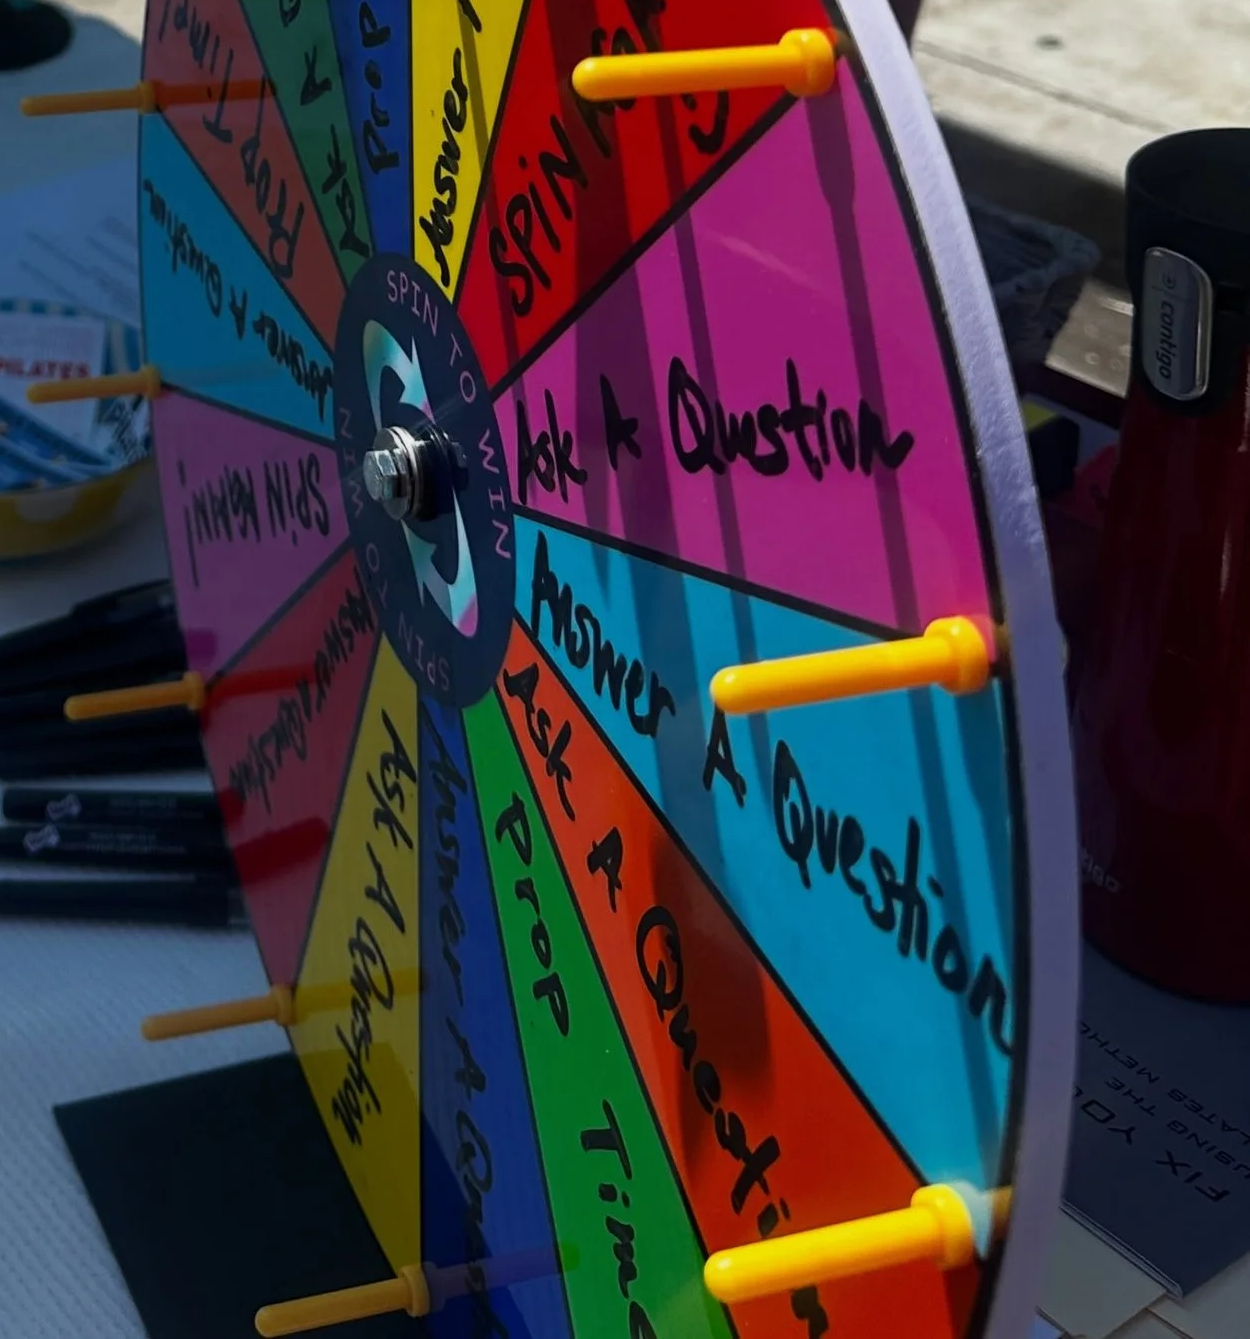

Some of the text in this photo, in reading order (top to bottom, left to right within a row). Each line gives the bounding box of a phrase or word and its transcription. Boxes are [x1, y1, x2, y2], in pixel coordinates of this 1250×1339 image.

[300, 45, 332, 106] A
[358, 2, 399, 174] Prop
[322, 125, 369, 259] Ask
[419, 48, 468, 288] Answer
[229, 283, 249, 341] A
[252, 311, 334, 426] Answer
[1155, 301, 1177, 379] contigo
[387, 269, 512, 560] SPIN TO WIN
[516, 356, 916, 506] Ask A Question
[366, 542, 389, 609] TO
[398, 611, 450, 692] SPIN
[530, 530, 1015, 1056] Answer A Question
[364, 841, 406, 934] A
[420, 697, 468, 1007] Answer
[446, 1015, 486, 1101] A
[495, 789, 570, 1038] Prop
[504, 662, 830, 1339] Ask A Questin
[1075, 1086, 1230, 1202] FIX YO
[1104, 1077, 1156, 1116] THE
